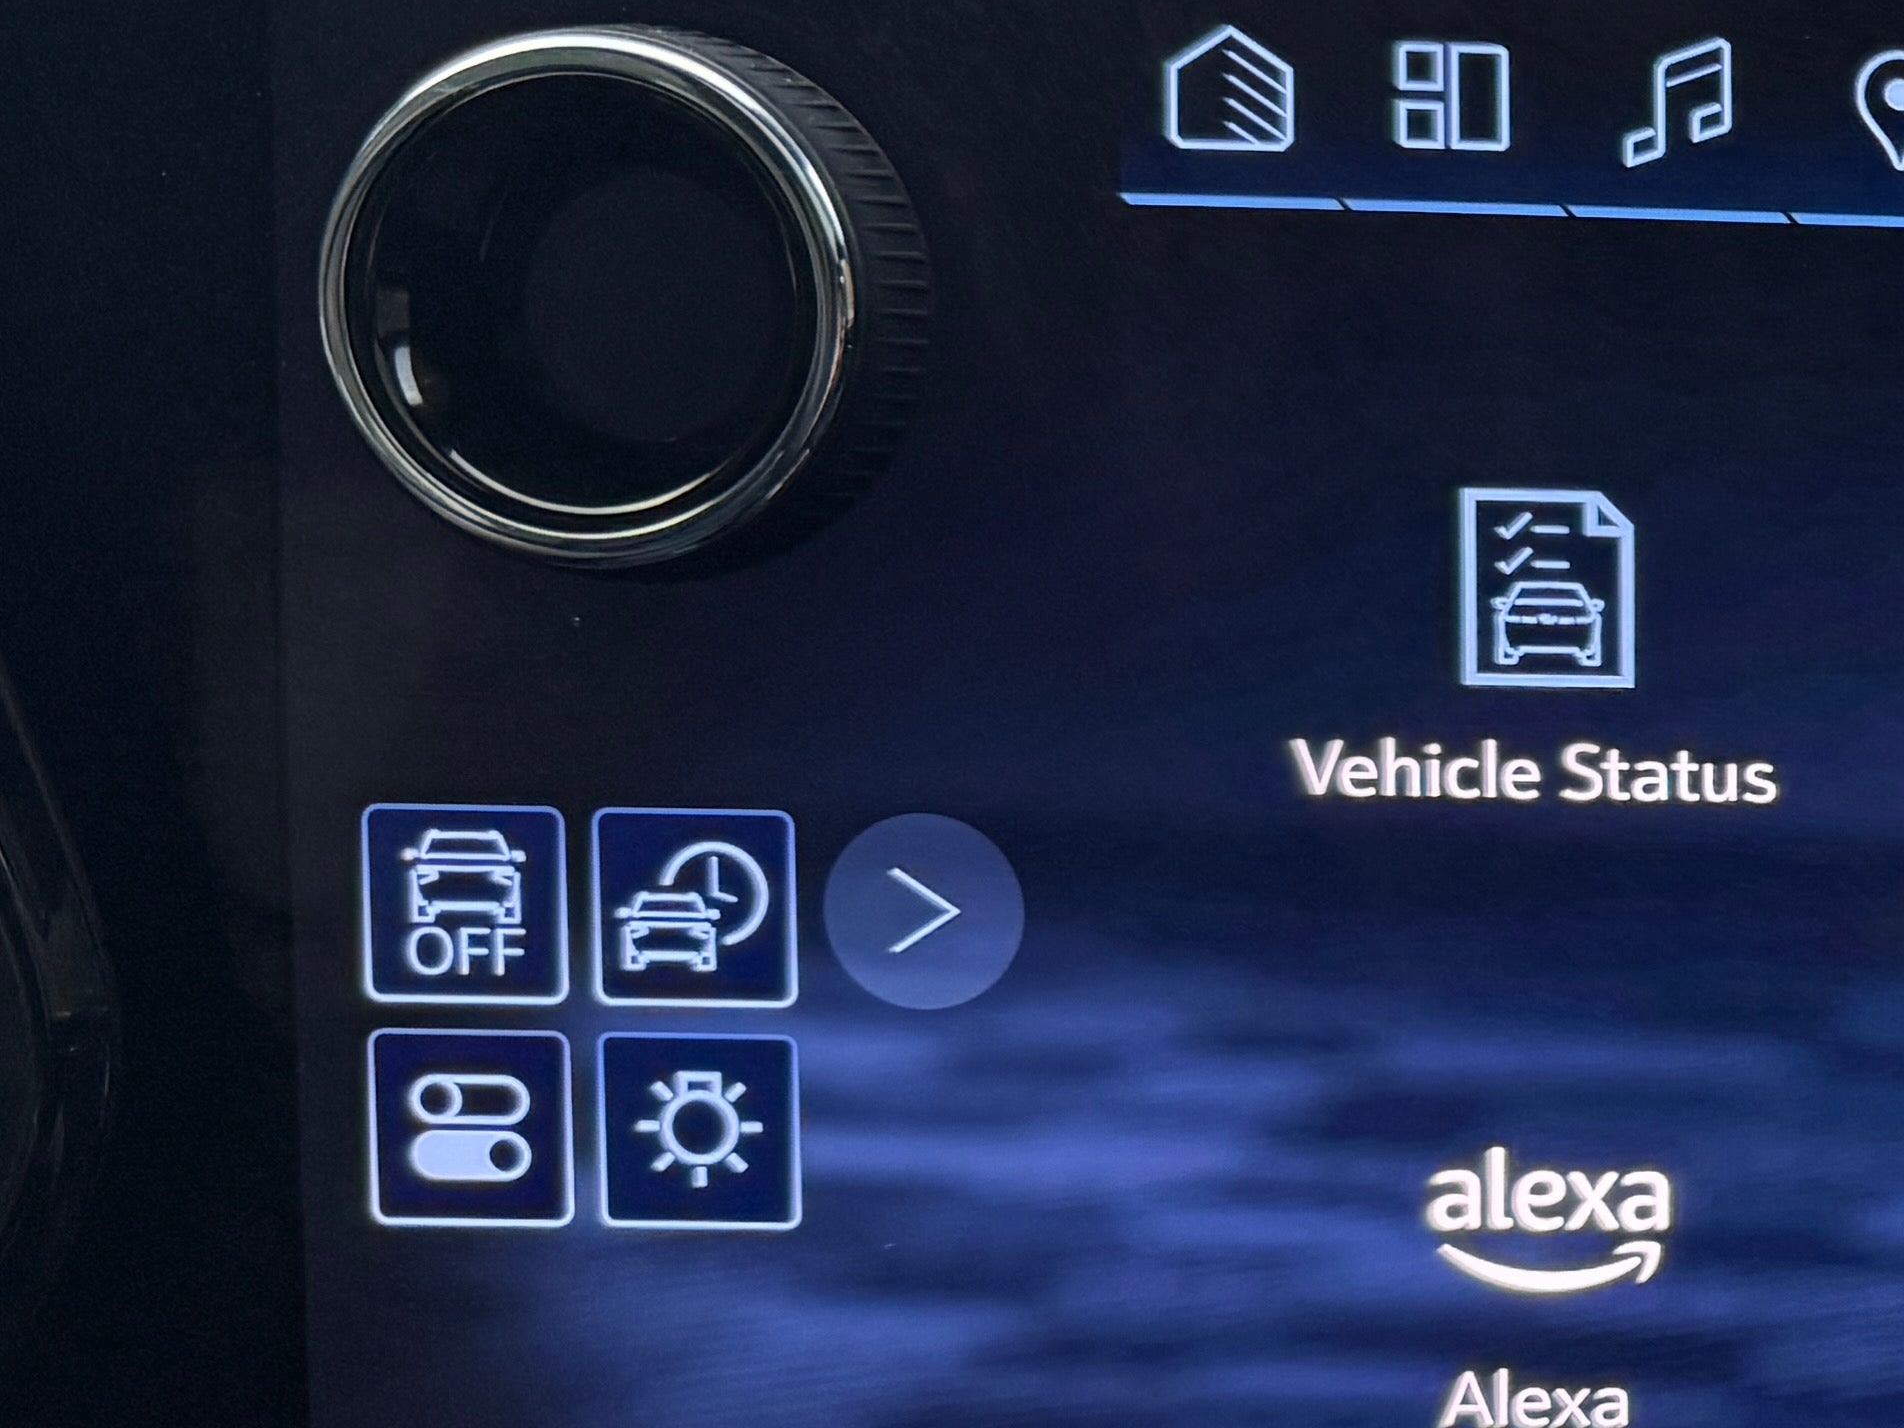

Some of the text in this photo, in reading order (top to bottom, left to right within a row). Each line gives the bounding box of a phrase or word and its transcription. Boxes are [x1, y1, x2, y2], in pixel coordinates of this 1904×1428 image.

[1290, 737, 1777, 803] Vehicle Status
[407, 927, 529, 975] OFF
[1425, 1146, 1671, 1232] alexa
